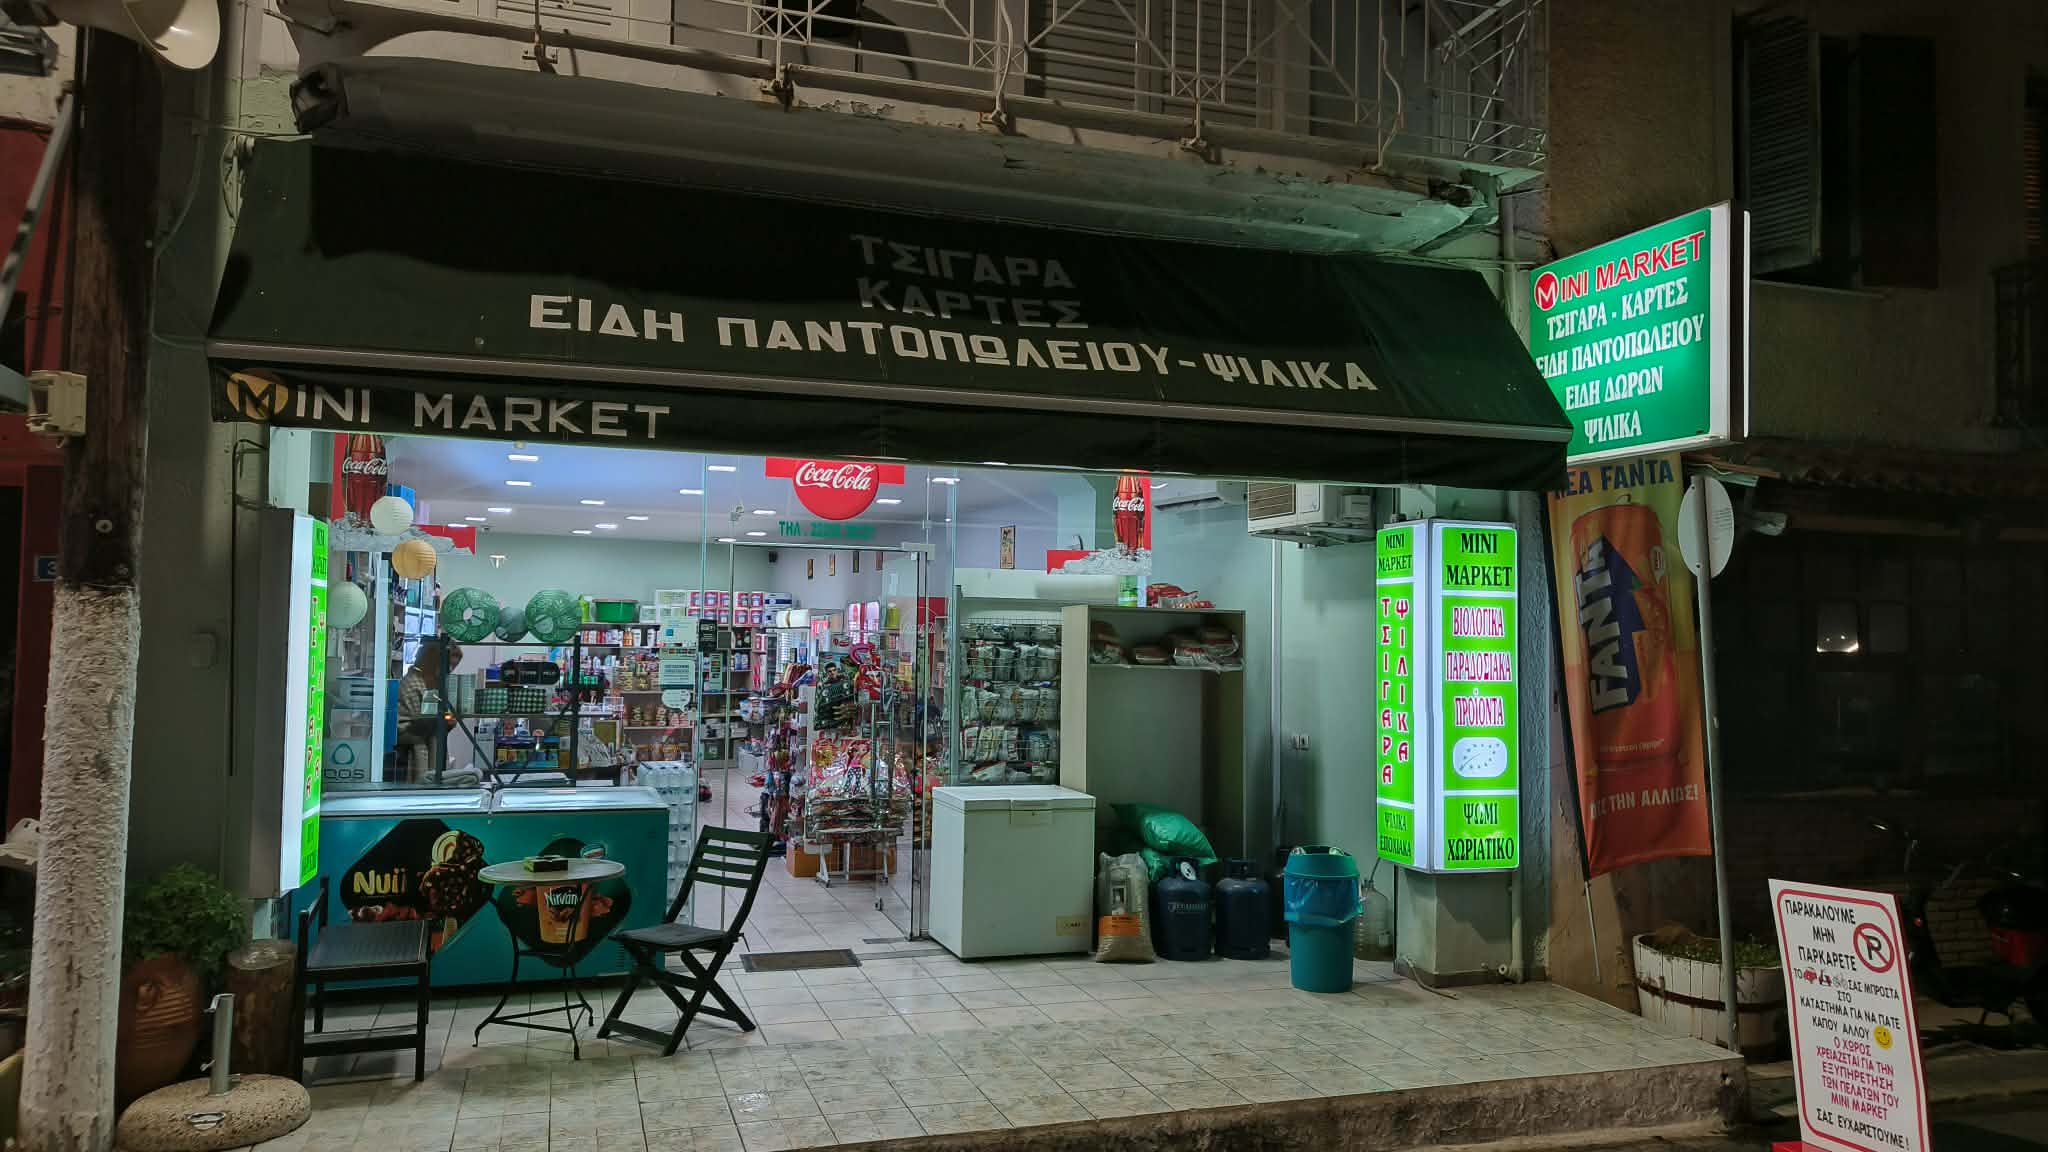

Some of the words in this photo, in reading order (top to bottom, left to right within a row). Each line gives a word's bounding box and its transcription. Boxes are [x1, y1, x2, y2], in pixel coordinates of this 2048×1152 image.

[850, 234, 1076, 289] ΤΣΙΓΑΡΑ
[1535, 271, 1588, 310] MINI
[1595, 231, 1705, 292] MARKET
[856, 277, 1088, 329] ΚΑΡΤΕΣ
[1547, 302, 1607, 341] ΤΣΙΓΑΡΑ
[1621, 277, 1688, 321] ΚΑΡΤΕΣ
[530, 295, 684, 343] ΕΙΔΗ
[1536, 350, 1568, 379] ΕΙΔΗ
[1572, 314, 1705, 372] ΠΑΝΤΟΠΩΛΕΙΟΥ
[1566, 379, 1601, 411] ΕΙΔΗ
[1604, 366, 1664, 403] ΔΩΡΩΝ
[226, 369, 370, 424] MINI
[414, 393, 670, 439] MARKET
[1584, 410, 1643, 444] ΨΙΛΙΚΑ
[796, 461, 877, 491] Coca-Cola
[1556, 470, 1593, 499] ΕΑ
[1600, 458, 1674, 491] FANTA
[1447, 565, 1512, 586] ΜΑΡΚΕΤ
[1453, 607, 1504, 638] ΒΙΟΛΟΓΙΚΑ
[1575, 533, 1629, 714] FANTA
[1446, 651, 1512, 681] ΠΑΡΑΔΟΣΙΑΚΑ
[323, 767, 366, 781] QOS
[1464, 803, 1498, 825] ΨΩΜΙ
[1448, 838, 1514, 861] ΧΩΡΙΑΤΙΚΟ
[353, 867, 408, 896] Nuii
[1784, 899, 1856, 925] ΠΑΡΑΚΑΛΟΥΜΕ
[1812, 925, 1835, 944] ΜΗΝ
[1798, 946, 1857, 972] ΠΑΡΚΑΡΕΤΕ
[1837, 991, 1852, 1003] ΣΤΟ
[1848, 980, 1863, 993] ΣΑΣ
[1864, 984, 1899, 1000] ΜΠΡΟΣΤΑ
[1800, 996, 1849, 1017] ΚΑΤΑΣΤΗΜΑ
[1850, 1007, 1862, 1020] ΓΙΑ
[1864, 1011, 1877, 1023] ΝΑ
[1878, 1014, 1901, 1030] ΠΑΤΕ
[1812, 1016, 1838, 1032] ΚΑΠΟΥ
[1842, 1023, 1870, 1040] ΑΛΛΟΥ
[1816, 1045, 1859, 1067] ΧΡΕΙΑΖΕΤΑΙ
[1861, 1057, 1874, 1072] ΓΙΑ
[1876, 1062, 1894, 1077] ΤΗΝ
[1842, 1039, 1871, 1056] ΧΩΡΟΣ
[1822, 1061, 1893, 1091] ΕΞΥΠΗΡΕΤΗΣΗ
[1822, 1075, 1838, 1090] ΤΩΝ
[1840, 1080, 1879, 1102] ΠΕΛΑΤΩΝ
[1882, 1093, 1899, 1108] ΤΟΥ
[1816, 1108, 1833, 1125] ΣΑΣ
[1852, 1099, 1887, 1120] ΜΑΡΚΕΤ
